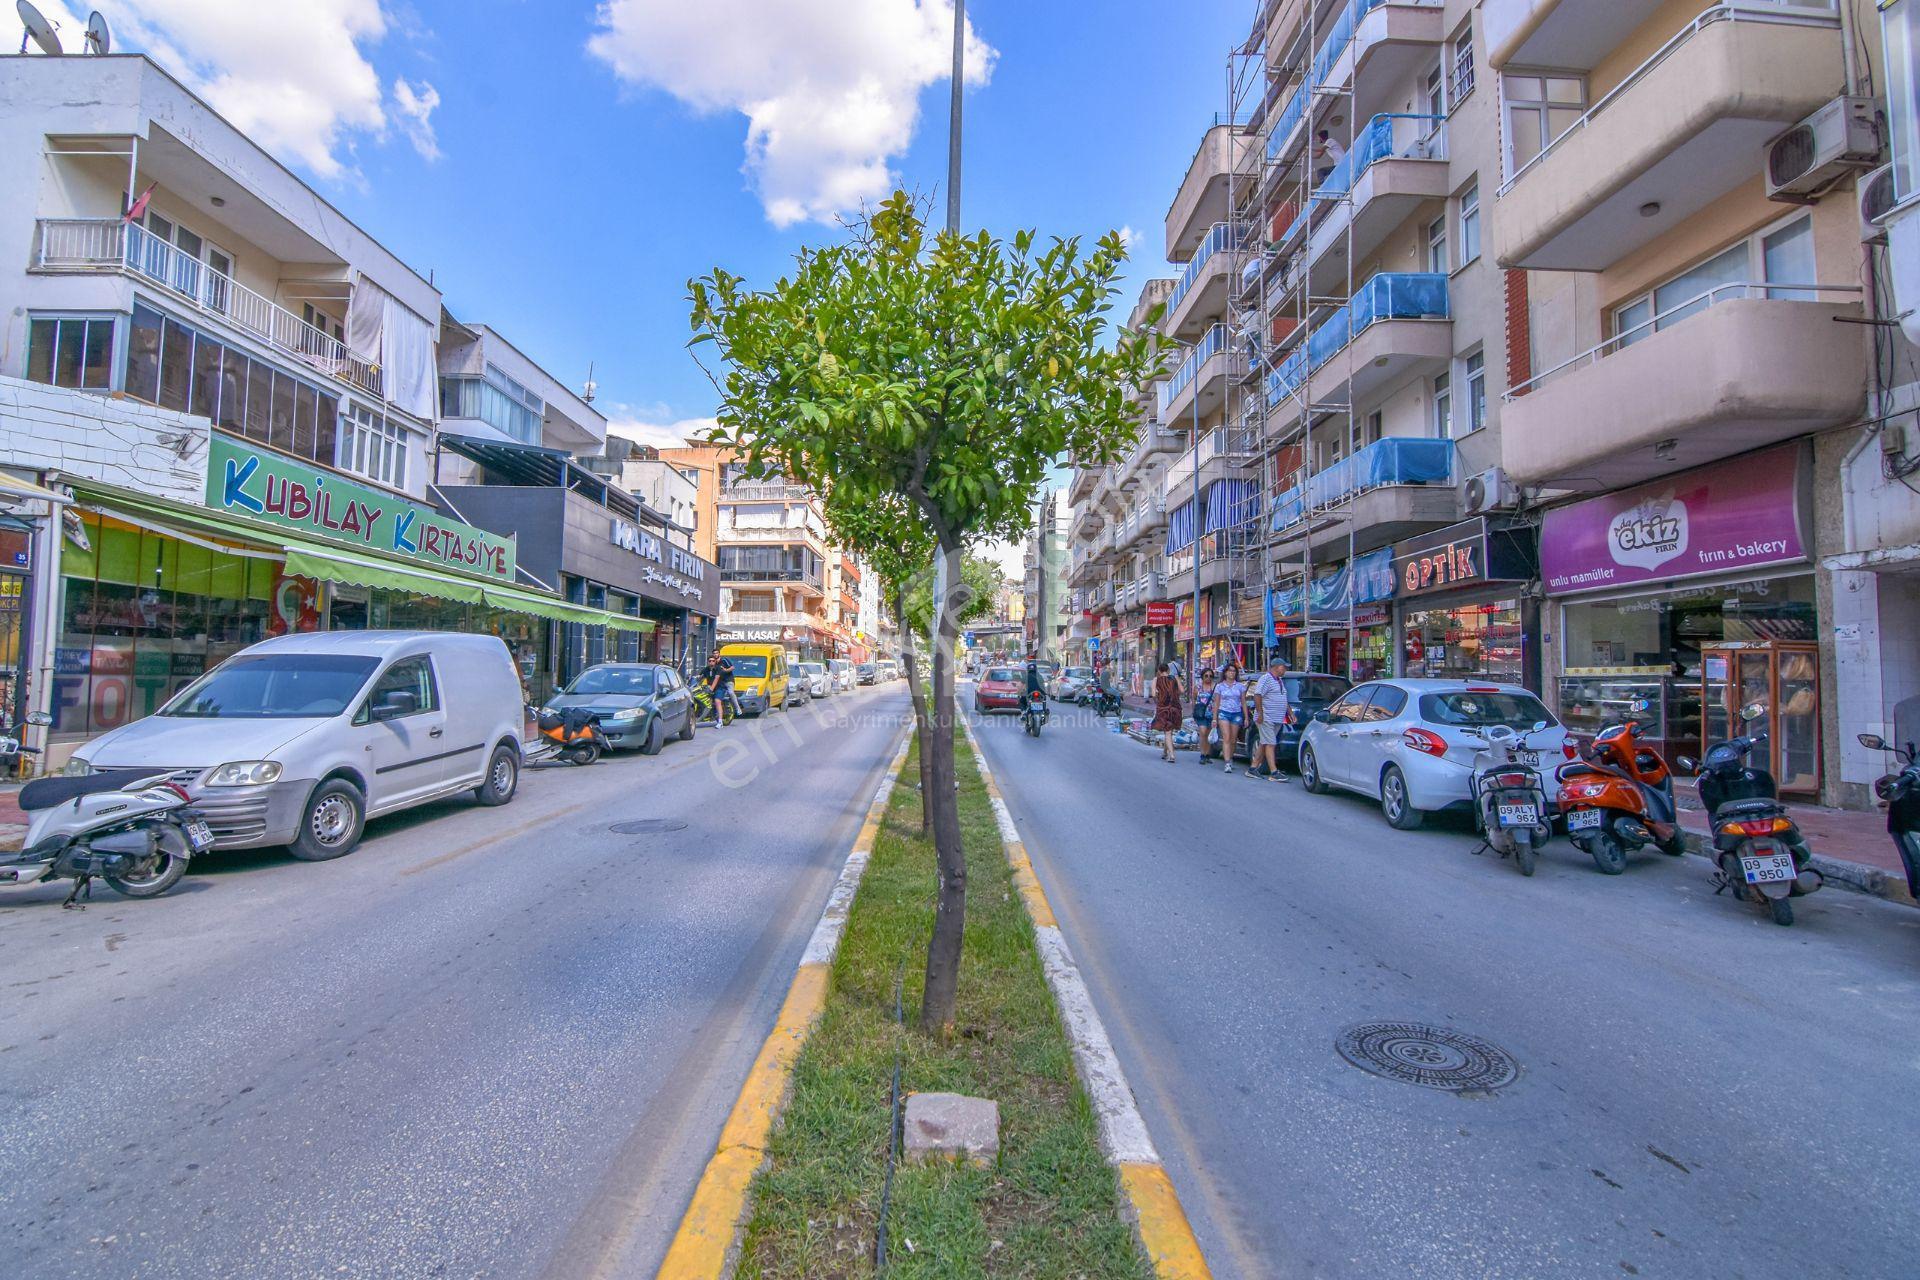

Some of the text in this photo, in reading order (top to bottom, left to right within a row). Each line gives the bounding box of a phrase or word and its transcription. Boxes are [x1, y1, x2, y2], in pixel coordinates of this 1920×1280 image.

[224, 456, 507, 574] KUBİLAY KIRTASİYE
[1619, 514, 1679, 551] ekiz
[613, 519, 704, 581] KARA FIRIN
[1655, 543, 1678, 553] FIRIN
[1728, 550, 1736, 559] &
[1737, 540, 1787, 558] bakery
[1406, 544, 1474, 590] OPTİK
[1550, 568, 1615, 588] unlu mamüller
[747, 630, 780, 641] KASAP
[1500, 805, 1534, 814] 09 ALY
[1516, 814, 1536, 823] 962
[1569, 813, 1580, 821] 09
[1744, 858, 1789, 870] 09 SB
[1759, 869, 1784, 880] 950
